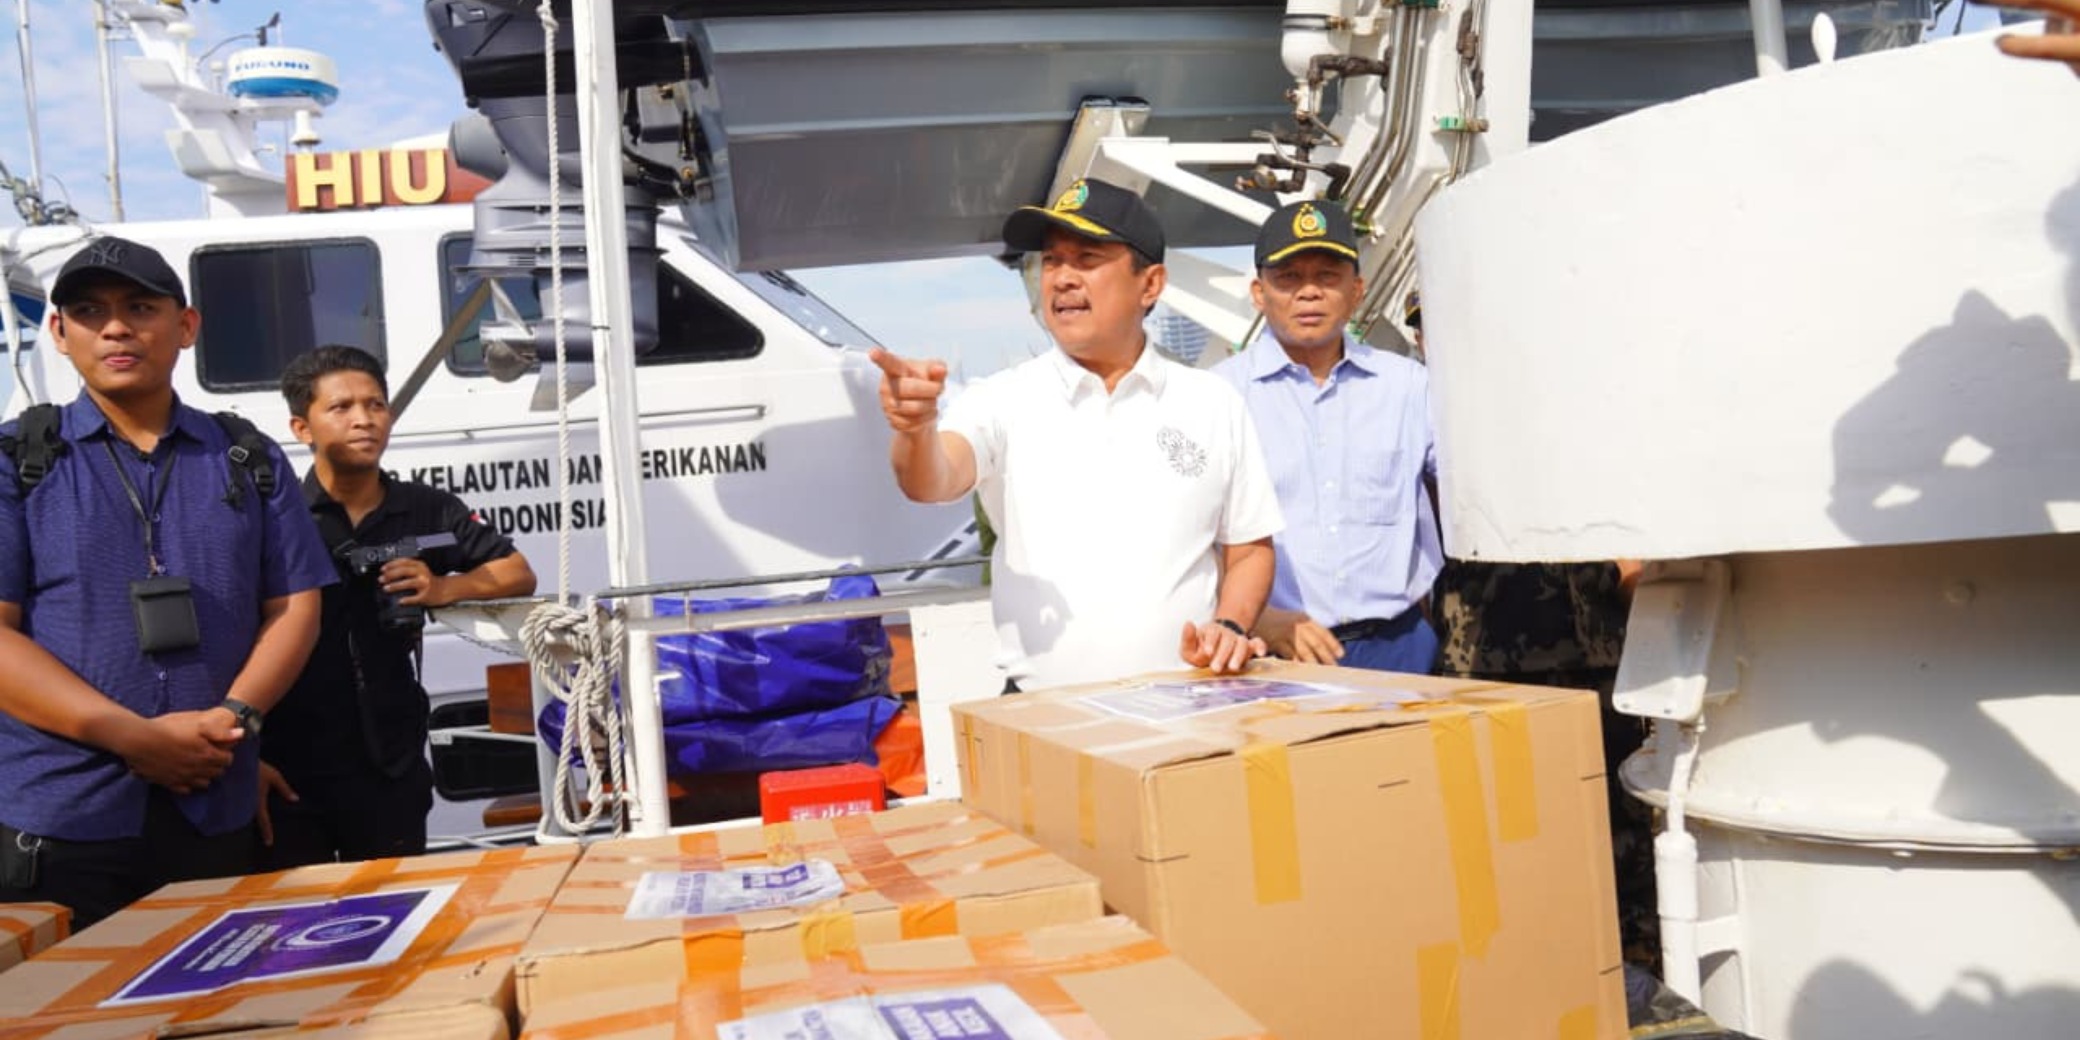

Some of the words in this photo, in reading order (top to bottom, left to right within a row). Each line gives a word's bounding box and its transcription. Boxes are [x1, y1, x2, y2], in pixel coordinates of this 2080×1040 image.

[295, 150, 446, 207] HIU
[411, 458, 550, 493] KELAUTAN
[641, 441, 767, 480] ERIKANAN
